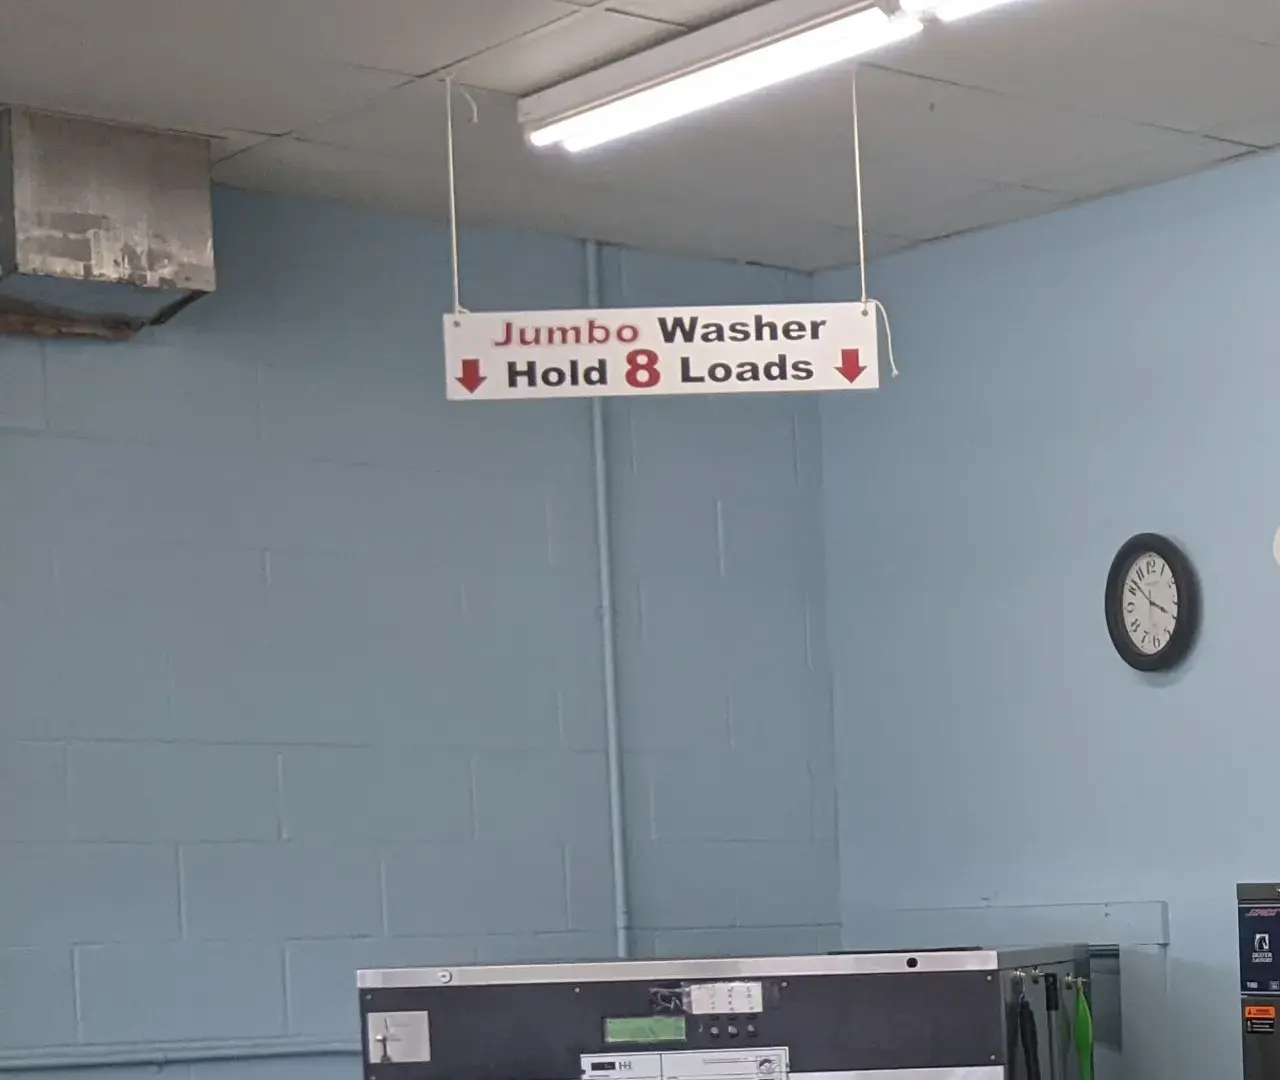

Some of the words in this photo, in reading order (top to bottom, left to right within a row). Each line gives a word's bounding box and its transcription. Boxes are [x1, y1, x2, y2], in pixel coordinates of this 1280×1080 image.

[493, 319, 640, 347] Jumbo
[658, 314, 827, 344] Washer
[507, 358, 608, 388] Hold
[625, 348, 661, 389] 8
[680, 353, 815, 384] Loads
[1153, 634, 1161, 649] 6
